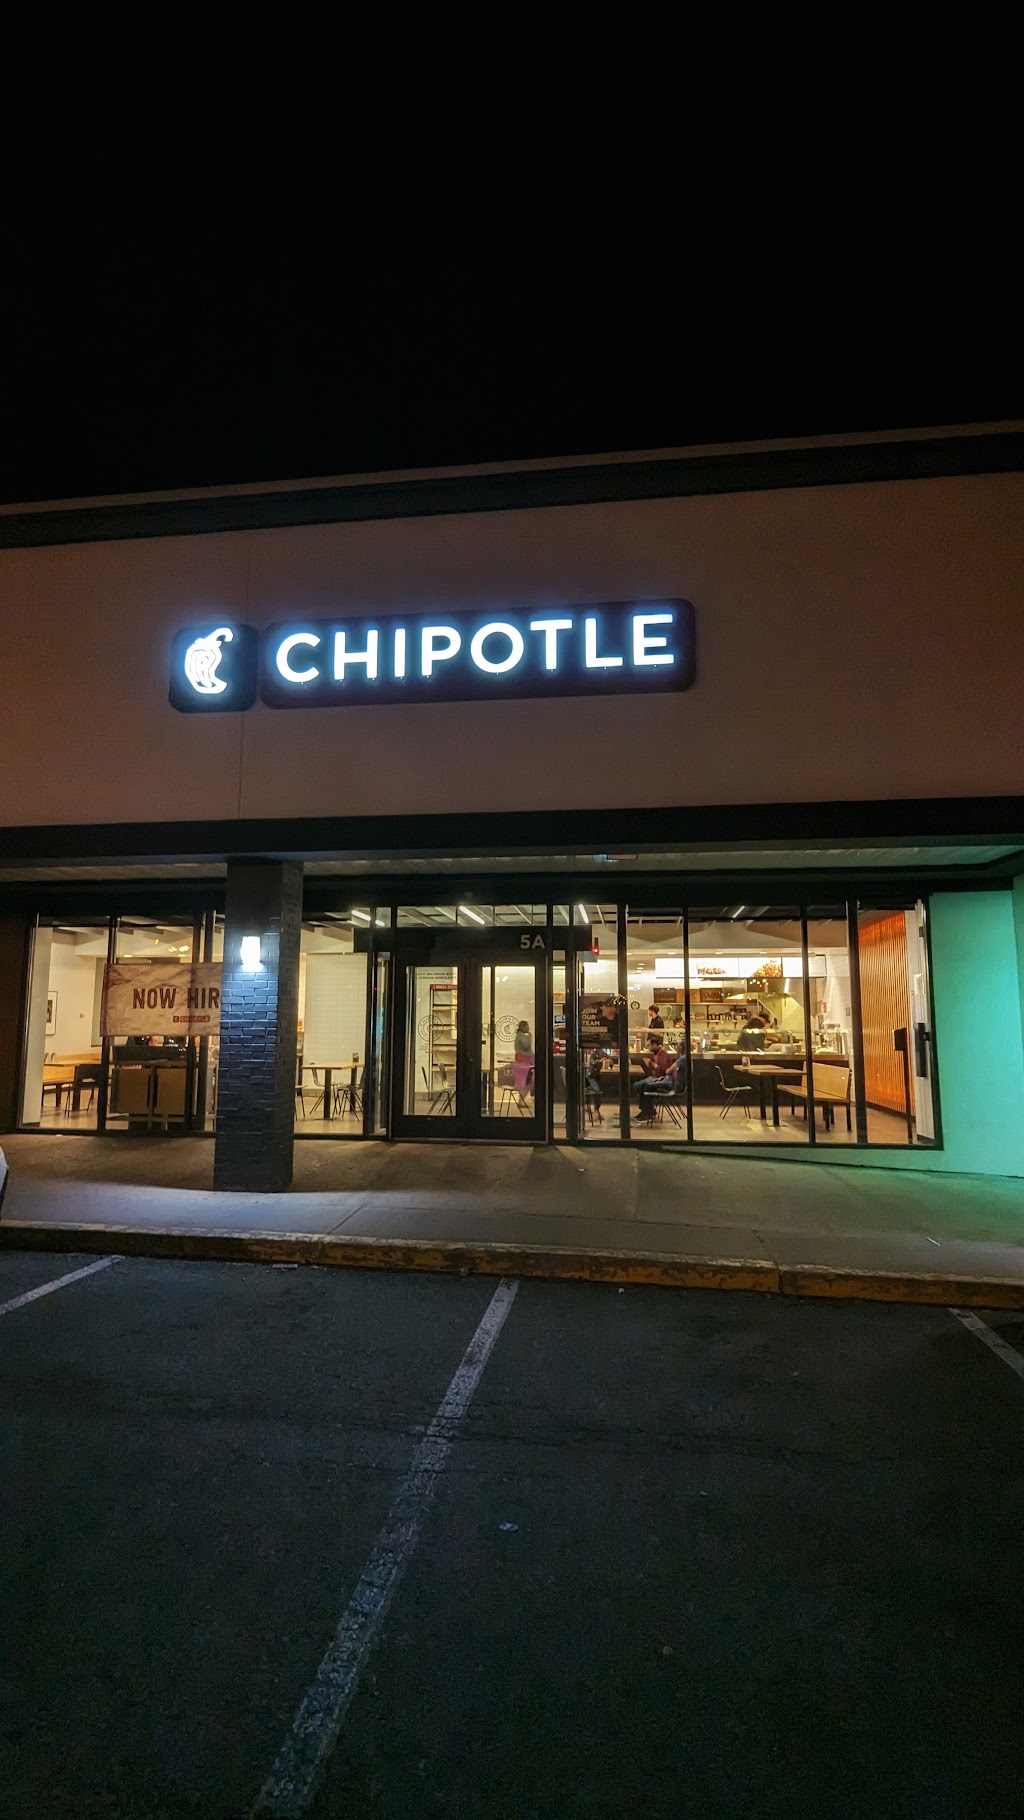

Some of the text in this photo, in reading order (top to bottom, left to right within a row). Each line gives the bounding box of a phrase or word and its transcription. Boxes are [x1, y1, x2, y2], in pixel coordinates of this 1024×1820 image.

[276, 614, 674, 683] CHIPOTLE
[520, 934, 546, 949] 5A
[133, 988, 176, 1009] NOW
